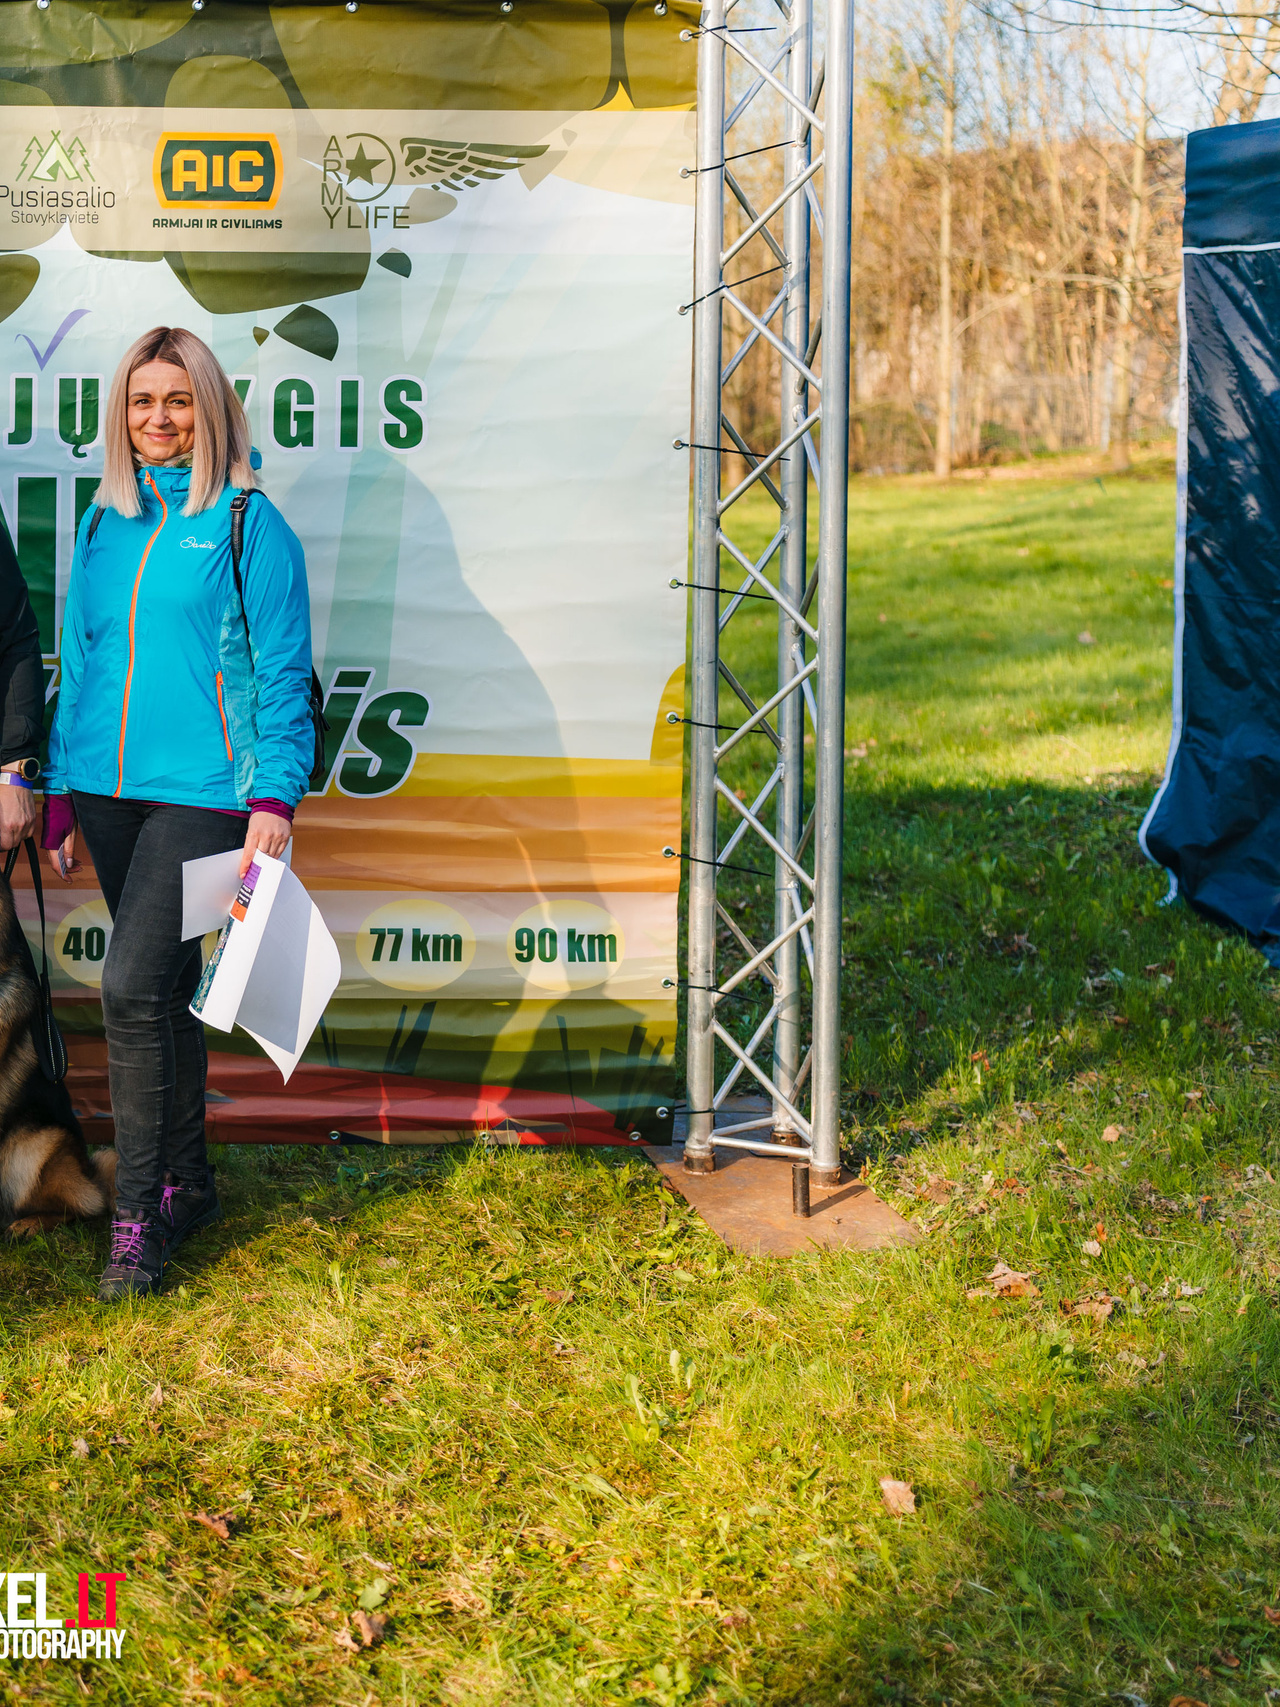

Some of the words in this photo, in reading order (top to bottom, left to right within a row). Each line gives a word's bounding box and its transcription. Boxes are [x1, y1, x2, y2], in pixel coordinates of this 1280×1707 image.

[172, 149, 264, 192] AIC
[11, 210, 99, 227] Stovyklavietė
[152, 218, 203, 229] ARMIJAI
[206, 218, 218, 229] IR
[221, 219, 283, 229] CIVILIAMS
[62, 926, 106, 962] 40
[369, 928, 404, 962] 77
[411, 928, 463, 962] km
[515, 927, 558, 963] 90
[567, 928, 618, 963] km
